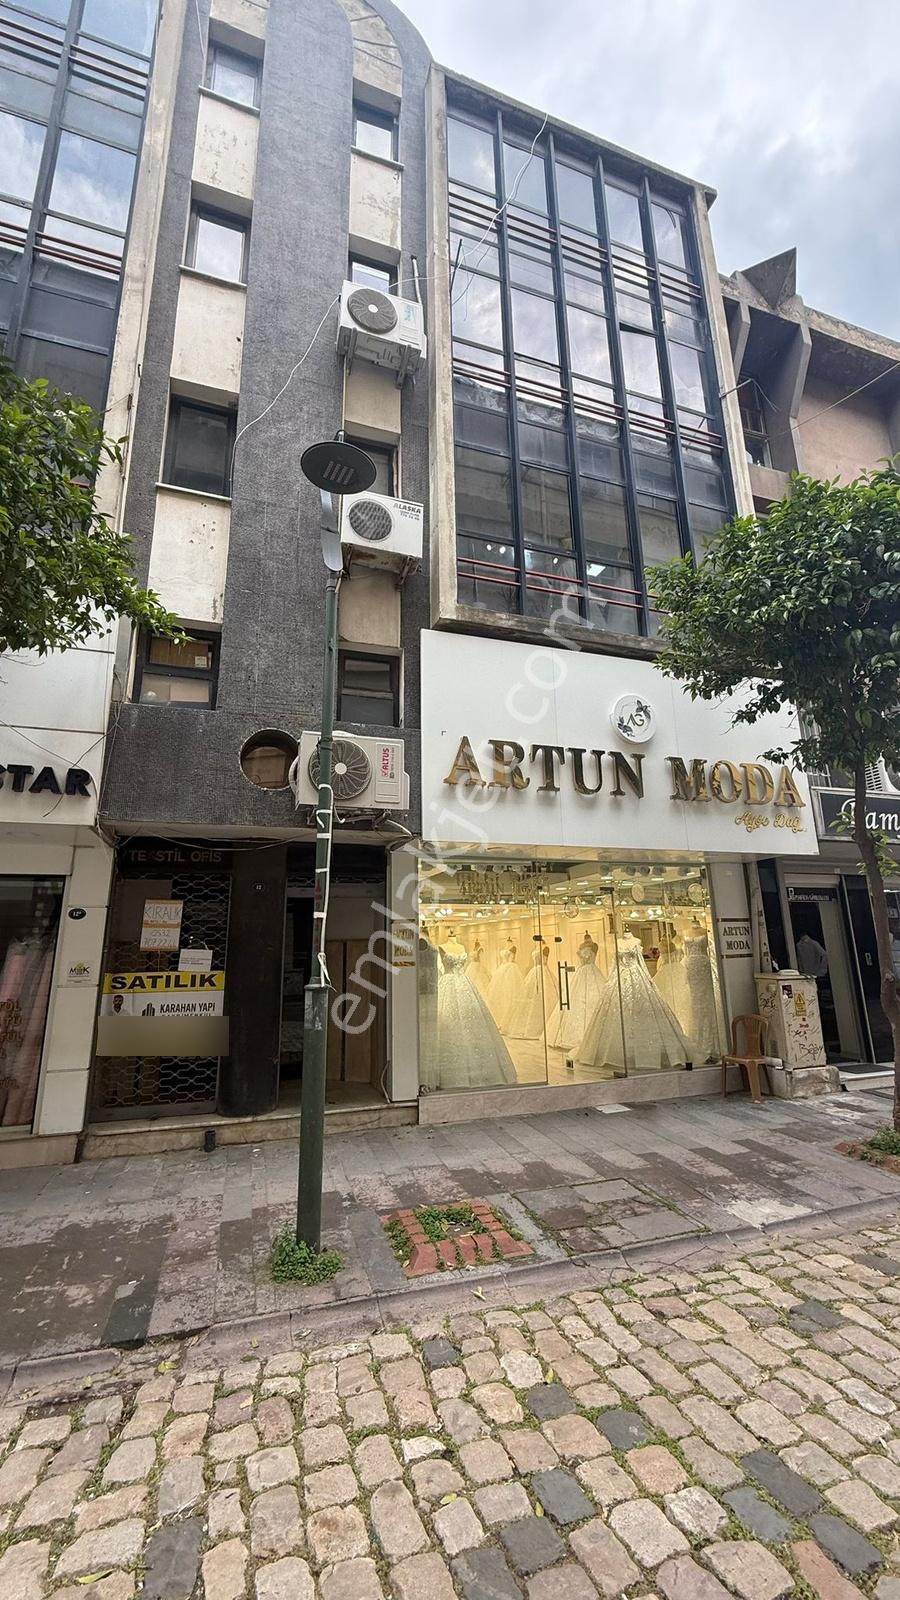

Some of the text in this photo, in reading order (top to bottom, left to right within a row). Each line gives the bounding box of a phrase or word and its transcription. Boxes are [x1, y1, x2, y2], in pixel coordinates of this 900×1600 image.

[393, 503, 421, 514] ALASKA
[382, 748, 390, 770] ALTUS
[443, 735, 646, 799] ARTUN
[664, 756, 806, 808] MODA
[0, 764, 92, 797] TAR
[723, 926, 750, 936] ARTUN
[726, 939, 750, 950] MODA
[111, 974, 217, 989] SATILIK
[160, 1002, 216, 1013] KARAHAN YAPI
